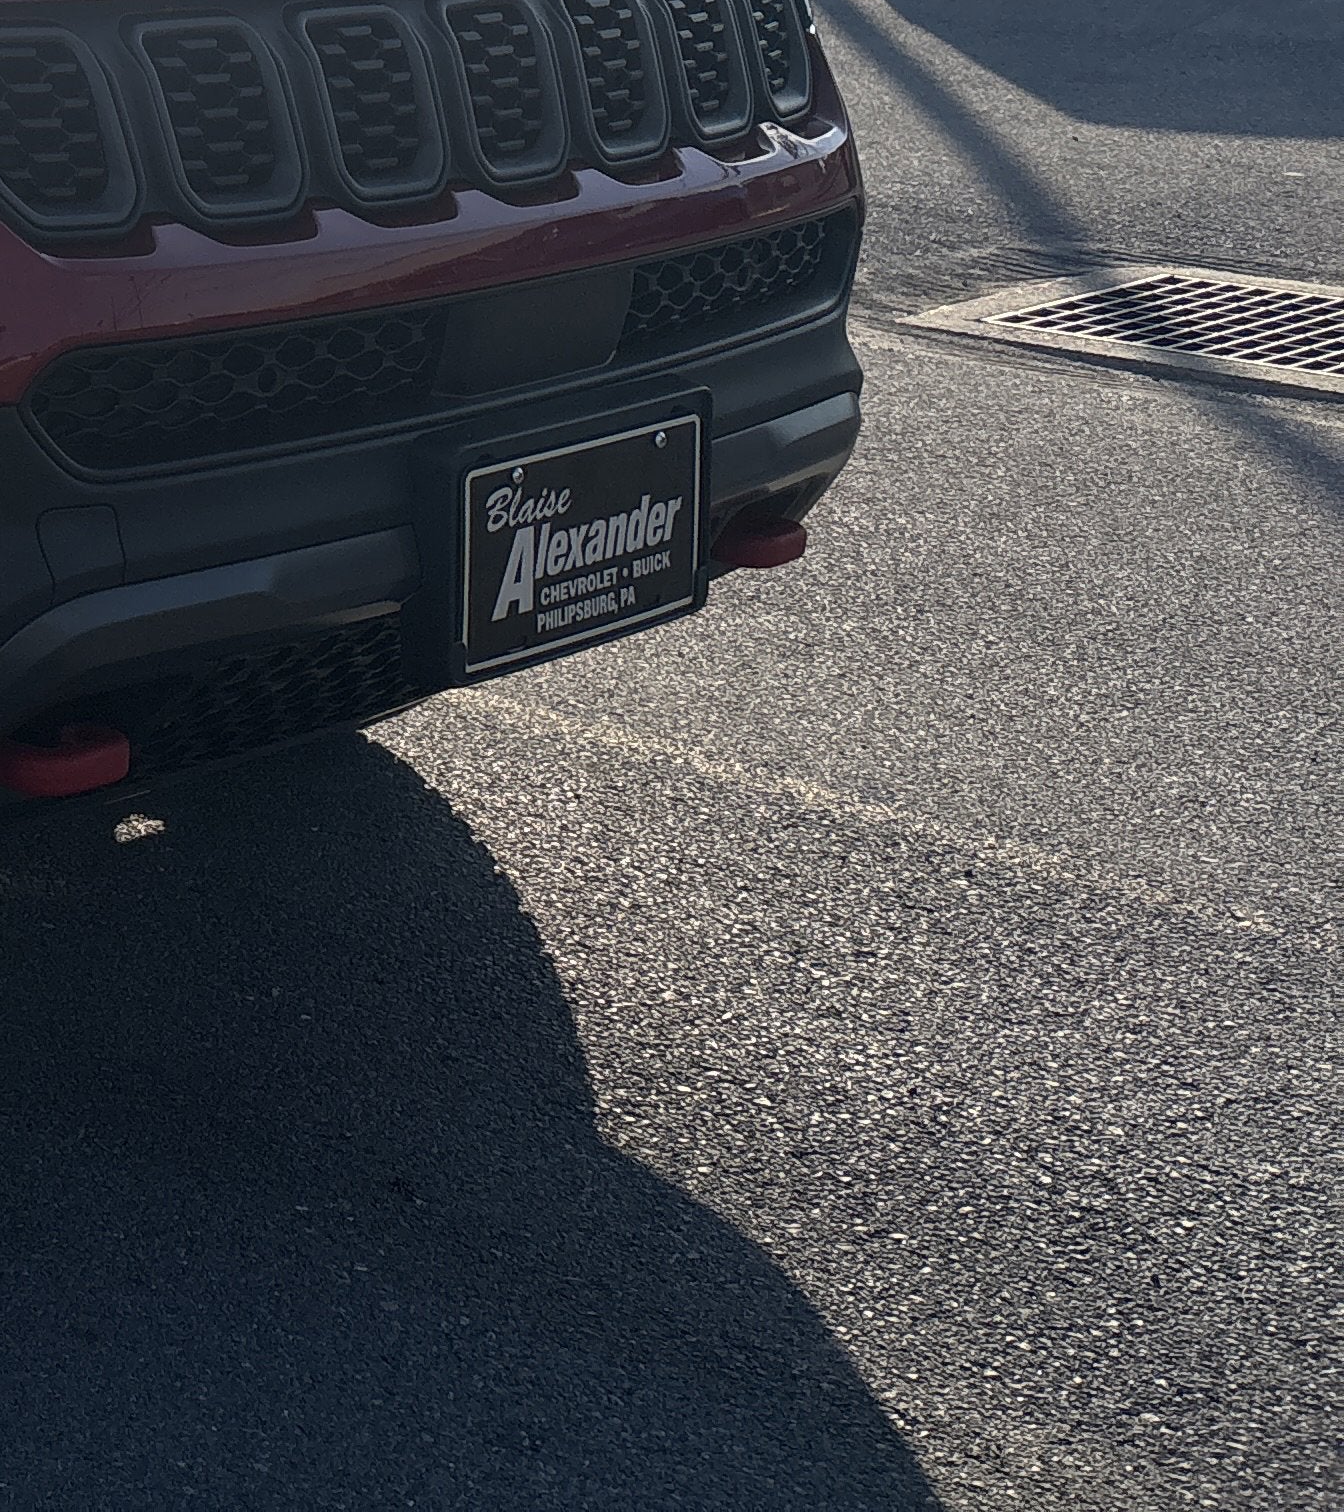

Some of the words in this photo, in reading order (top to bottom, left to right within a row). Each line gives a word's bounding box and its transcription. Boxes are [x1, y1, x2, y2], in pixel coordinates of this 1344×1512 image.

[485, 487, 572, 533] Blaise
[491, 494, 683, 622] Alexander
[540, 567, 618, 605] CHEVROLET
[632, 551, 671, 579] BUICK
[536, 595, 618, 633] PHILIPSBURG,
[620, 585, 636, 606] PA
